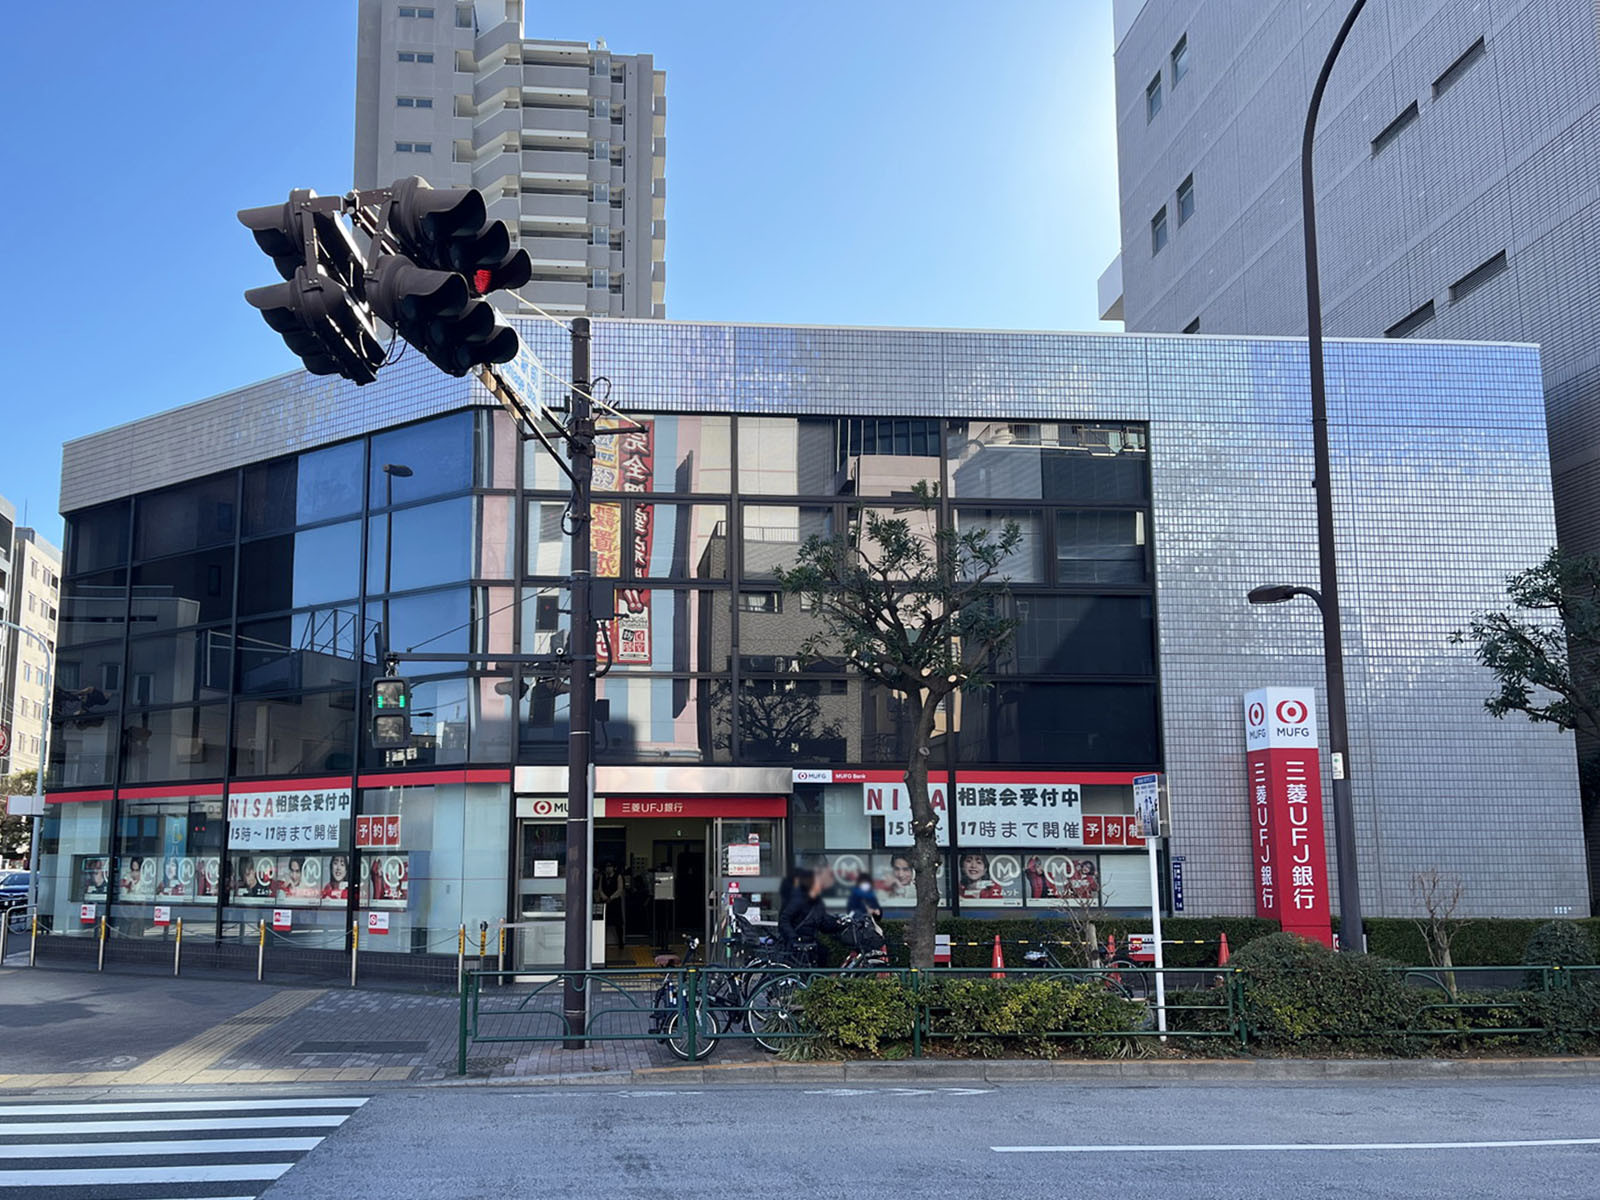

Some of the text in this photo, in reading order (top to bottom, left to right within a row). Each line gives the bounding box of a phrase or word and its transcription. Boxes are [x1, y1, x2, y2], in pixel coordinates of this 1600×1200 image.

[1249, 729, 1267, 741] MUFG
[1276, 727, 1310, 738] MUFG
[866, 788, 947, 811] NIA
[957, 787, 1079, 809] 相談会受付中
[622, 802, 684, 813] 三菱UFJ銀行
[358, 823, 399, 839] 予約制
[1254, 762, 1274, 909] 三菱UFJ銀行
[1285, 761, 1316, 910] 三菱UFJ銀行
[992, 888, 1020, 897] エムット
